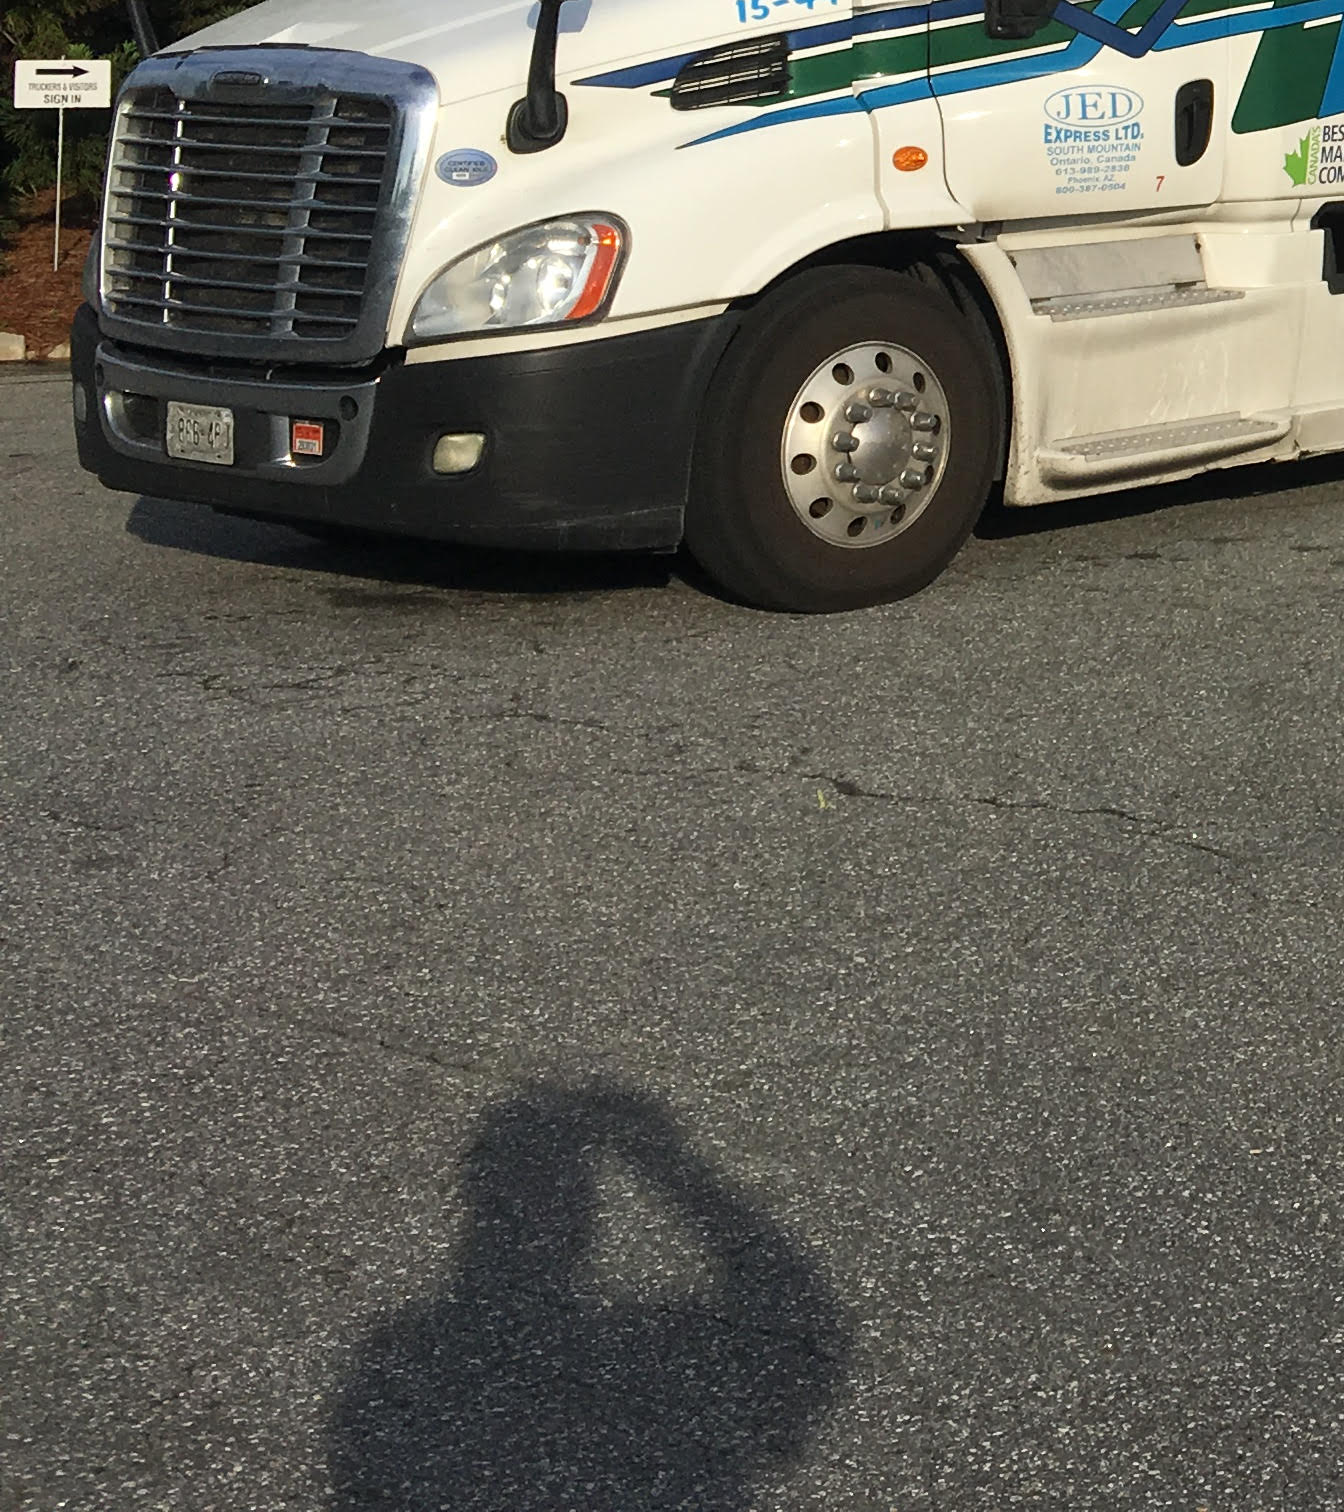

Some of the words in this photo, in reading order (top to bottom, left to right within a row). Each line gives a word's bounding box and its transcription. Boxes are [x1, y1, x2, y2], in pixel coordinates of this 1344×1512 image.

[28, 82, 60, 91] TRUCKERS
[69, 83, 98, 91] VISITORS
[43, 94, 68, 104] SIGN
[71, 94, 82, 103] IN
[1056, 92, 1133, 120] JED
[1044, 123, 1110, 144] EXPRESS
[1047, 145, 1085, 156] SOUTH
[1087, 142, 1142, 154] MOUNTAIN
[1096, 153, 1137, 164] Canada
[1155, 175, 1165, 192] 7
